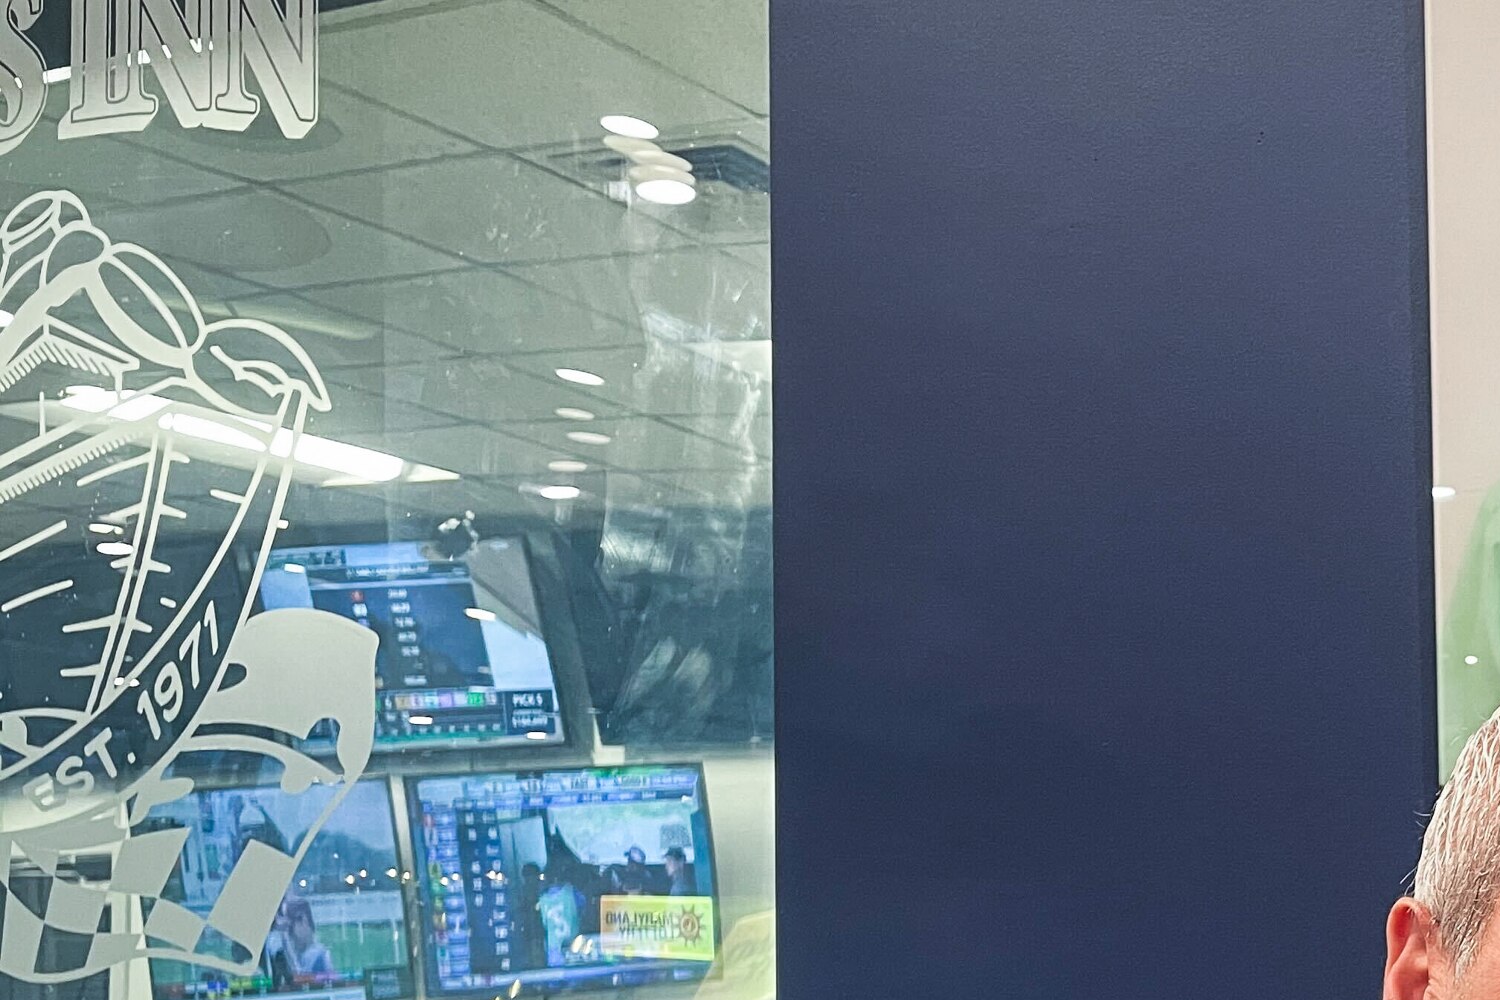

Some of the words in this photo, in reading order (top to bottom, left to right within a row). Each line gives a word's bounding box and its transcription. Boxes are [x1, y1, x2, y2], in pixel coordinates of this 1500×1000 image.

[58, 0, 318, 139] INN
[23, 727, 136, 812] EST.
[137, 600, 219, 740] 1971
